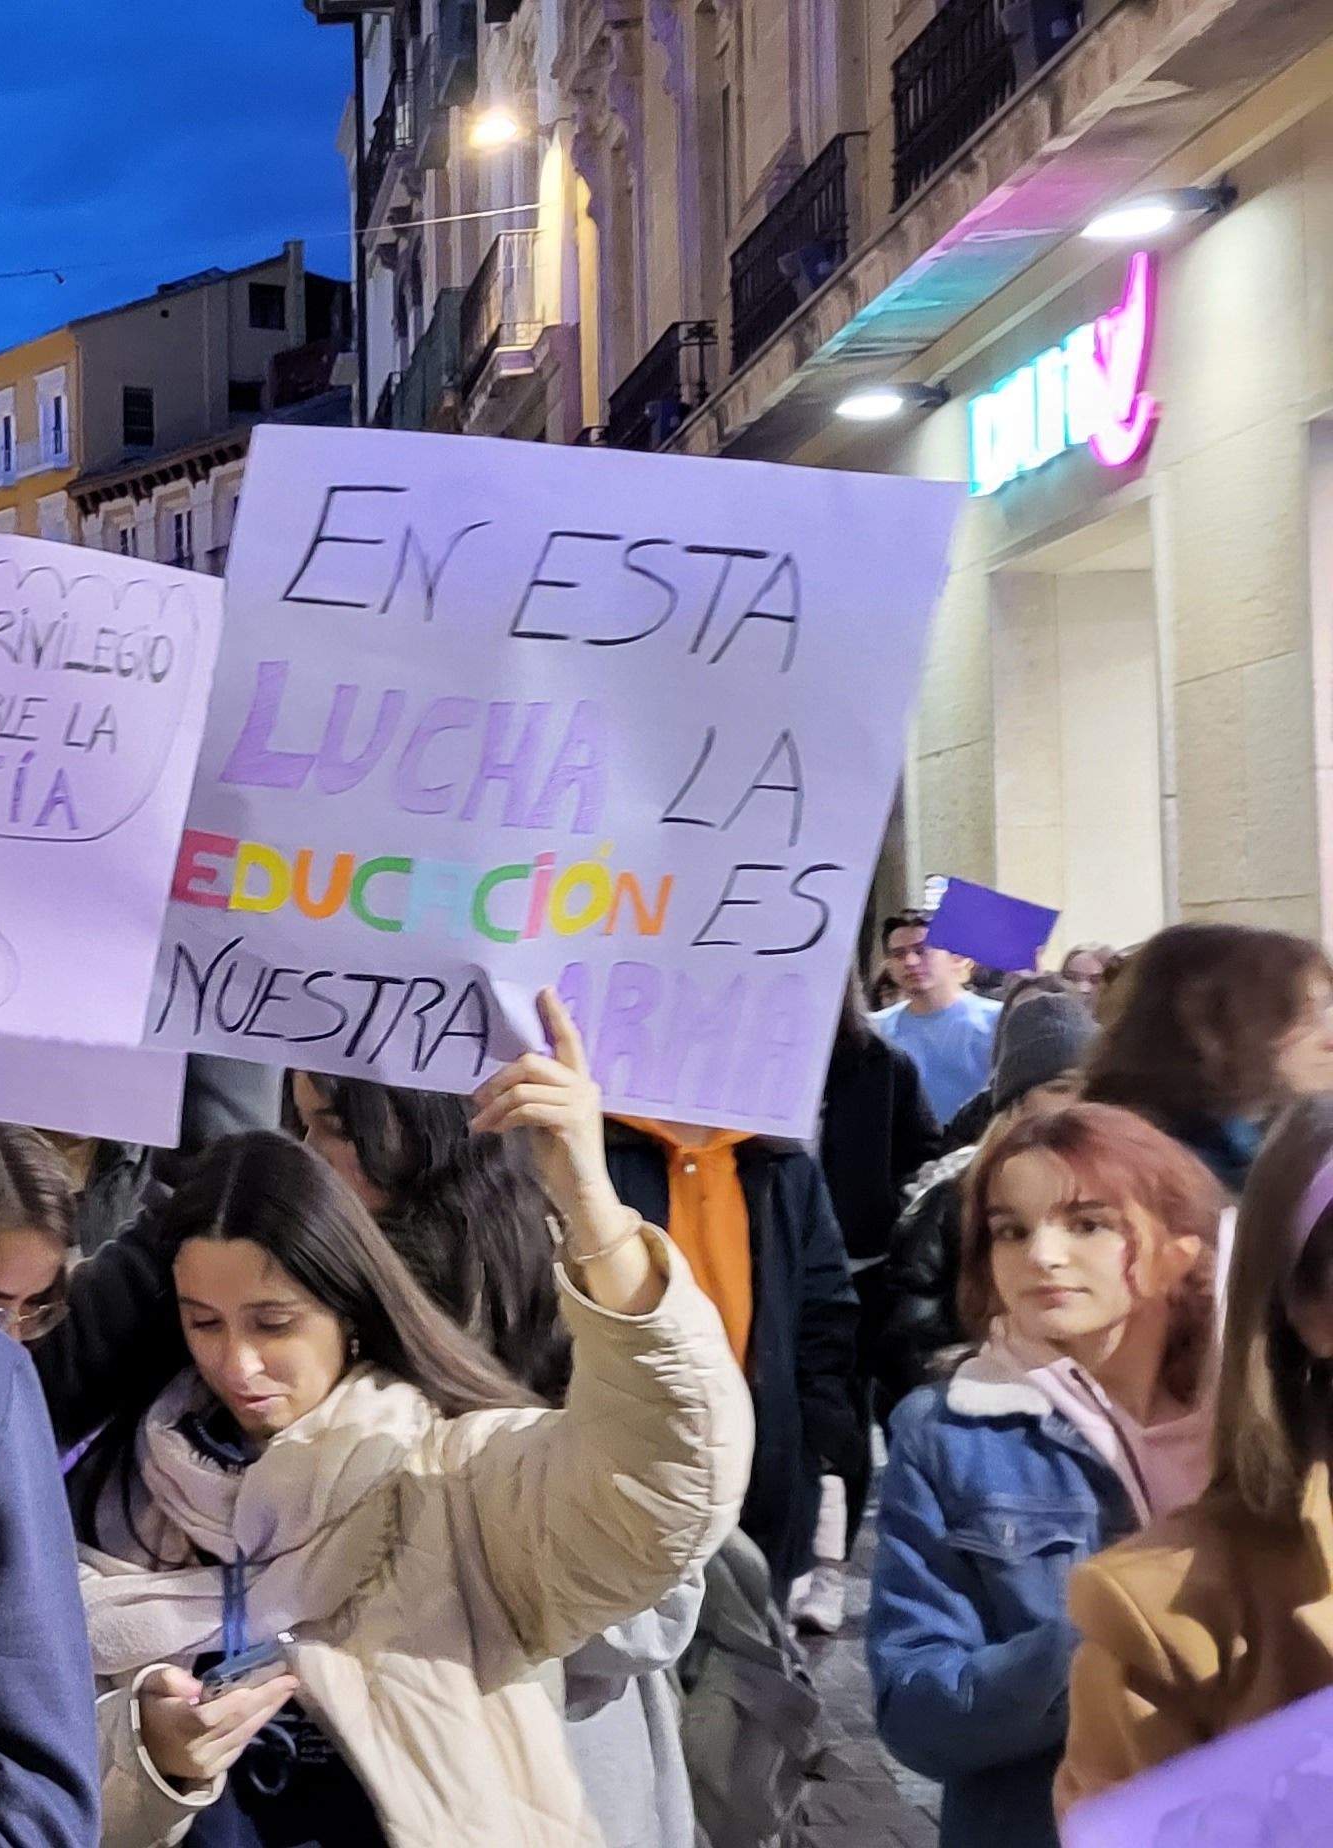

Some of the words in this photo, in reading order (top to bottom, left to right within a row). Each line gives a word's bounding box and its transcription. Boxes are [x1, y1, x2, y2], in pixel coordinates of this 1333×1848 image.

[281, 485, 493, 622] EN
[510, 529, 805, 674] ESTA
[63, 702, 119, 754] LA
[220, 660, 612, 833] LUCHA
[659, 726, 805, 848] LA
[691, 862, 847, 957] ES
[155, 936, 492, 1077] NUESTRA
